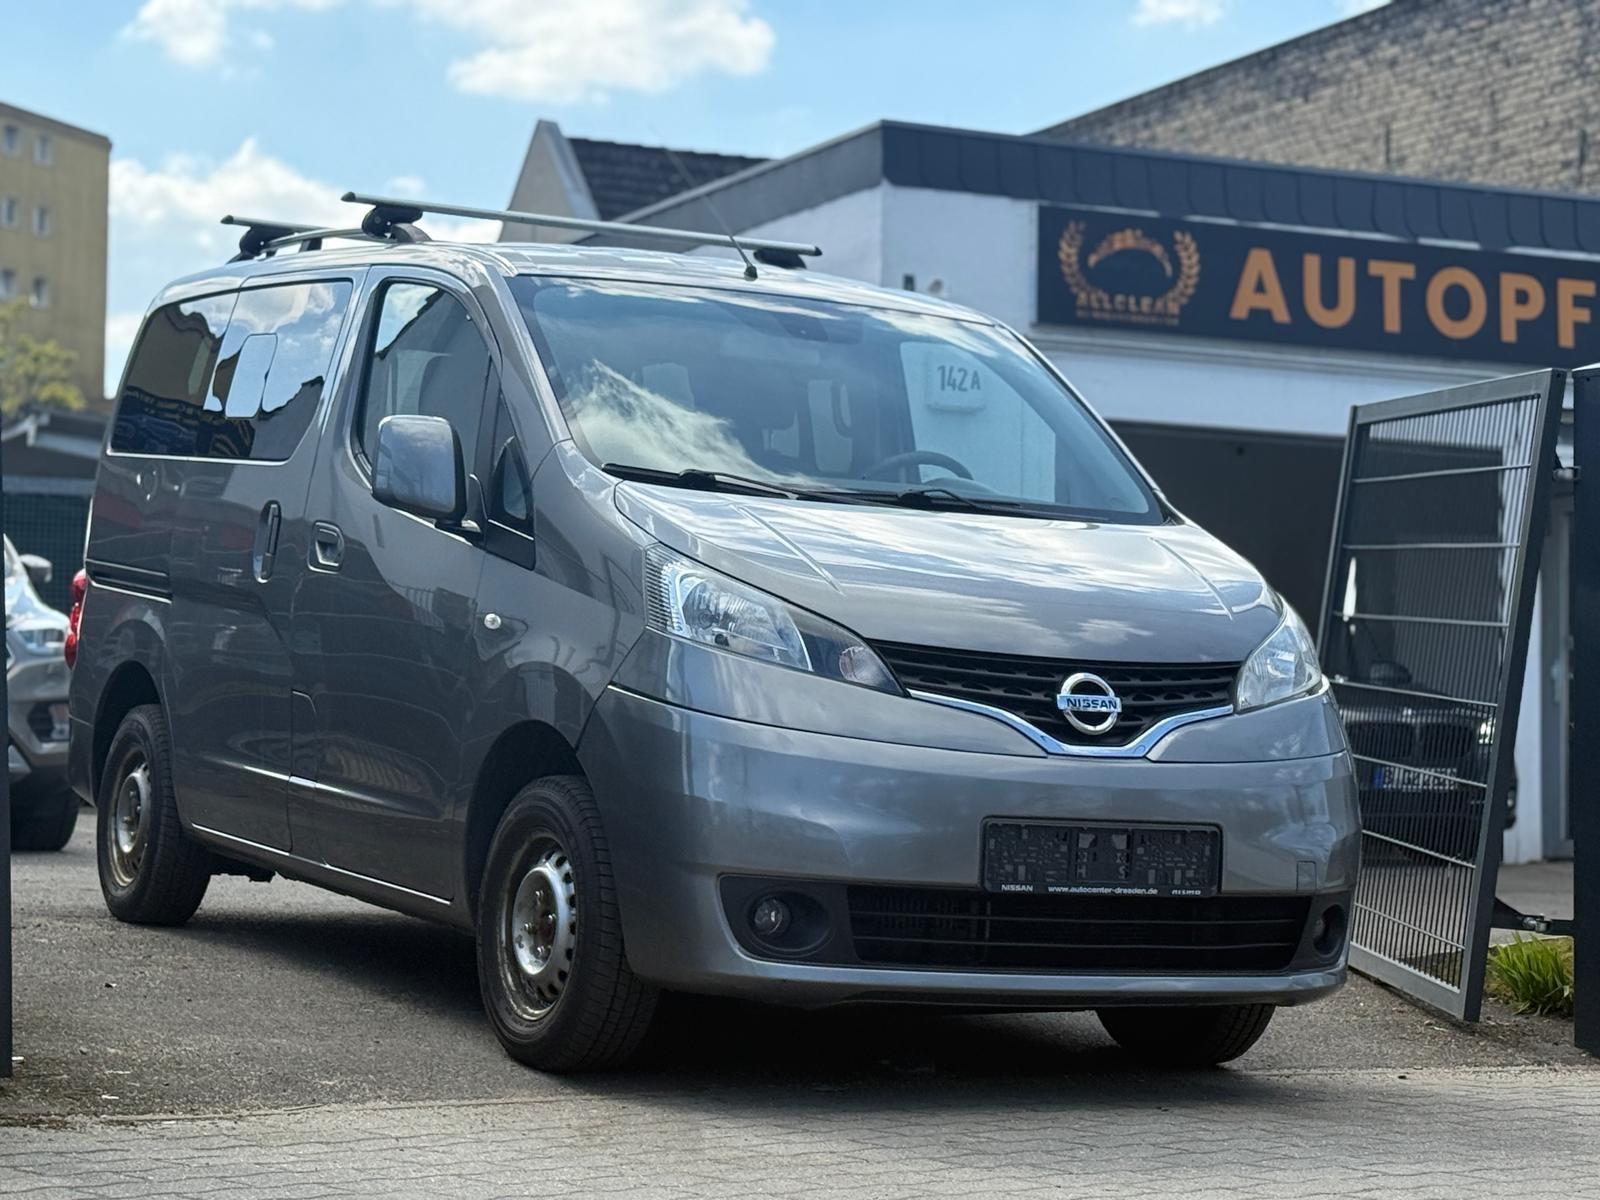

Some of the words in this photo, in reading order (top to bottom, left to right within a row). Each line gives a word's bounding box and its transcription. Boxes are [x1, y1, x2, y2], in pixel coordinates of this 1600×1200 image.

[1229, 247, 1596, 349] AUTOPF
[1066, 698, 1117, 709] NISSAN
[1001, 884, 1034, 892] NISSAN
[1047, 886, 1159, 895] www.autocenter-dresden.de
